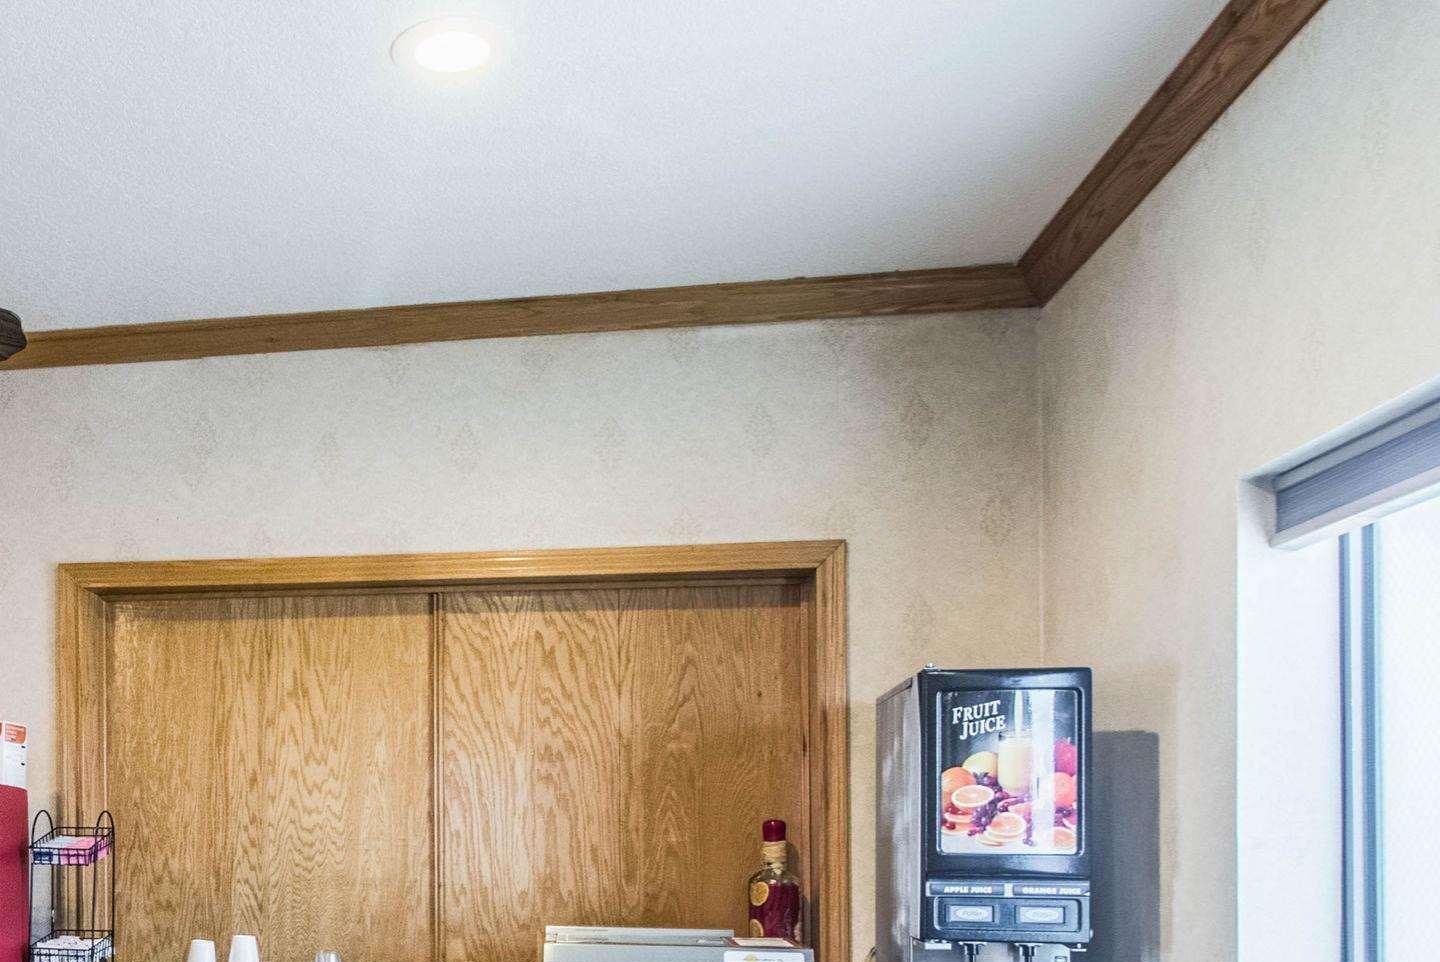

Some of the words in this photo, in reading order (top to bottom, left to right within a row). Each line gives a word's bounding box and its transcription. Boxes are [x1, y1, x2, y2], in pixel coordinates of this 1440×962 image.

[952, 700, 1001, 724] FRUIT
[960, 715, 1006, 740] JUICE
[971, 886, 993, 894] JUICE
